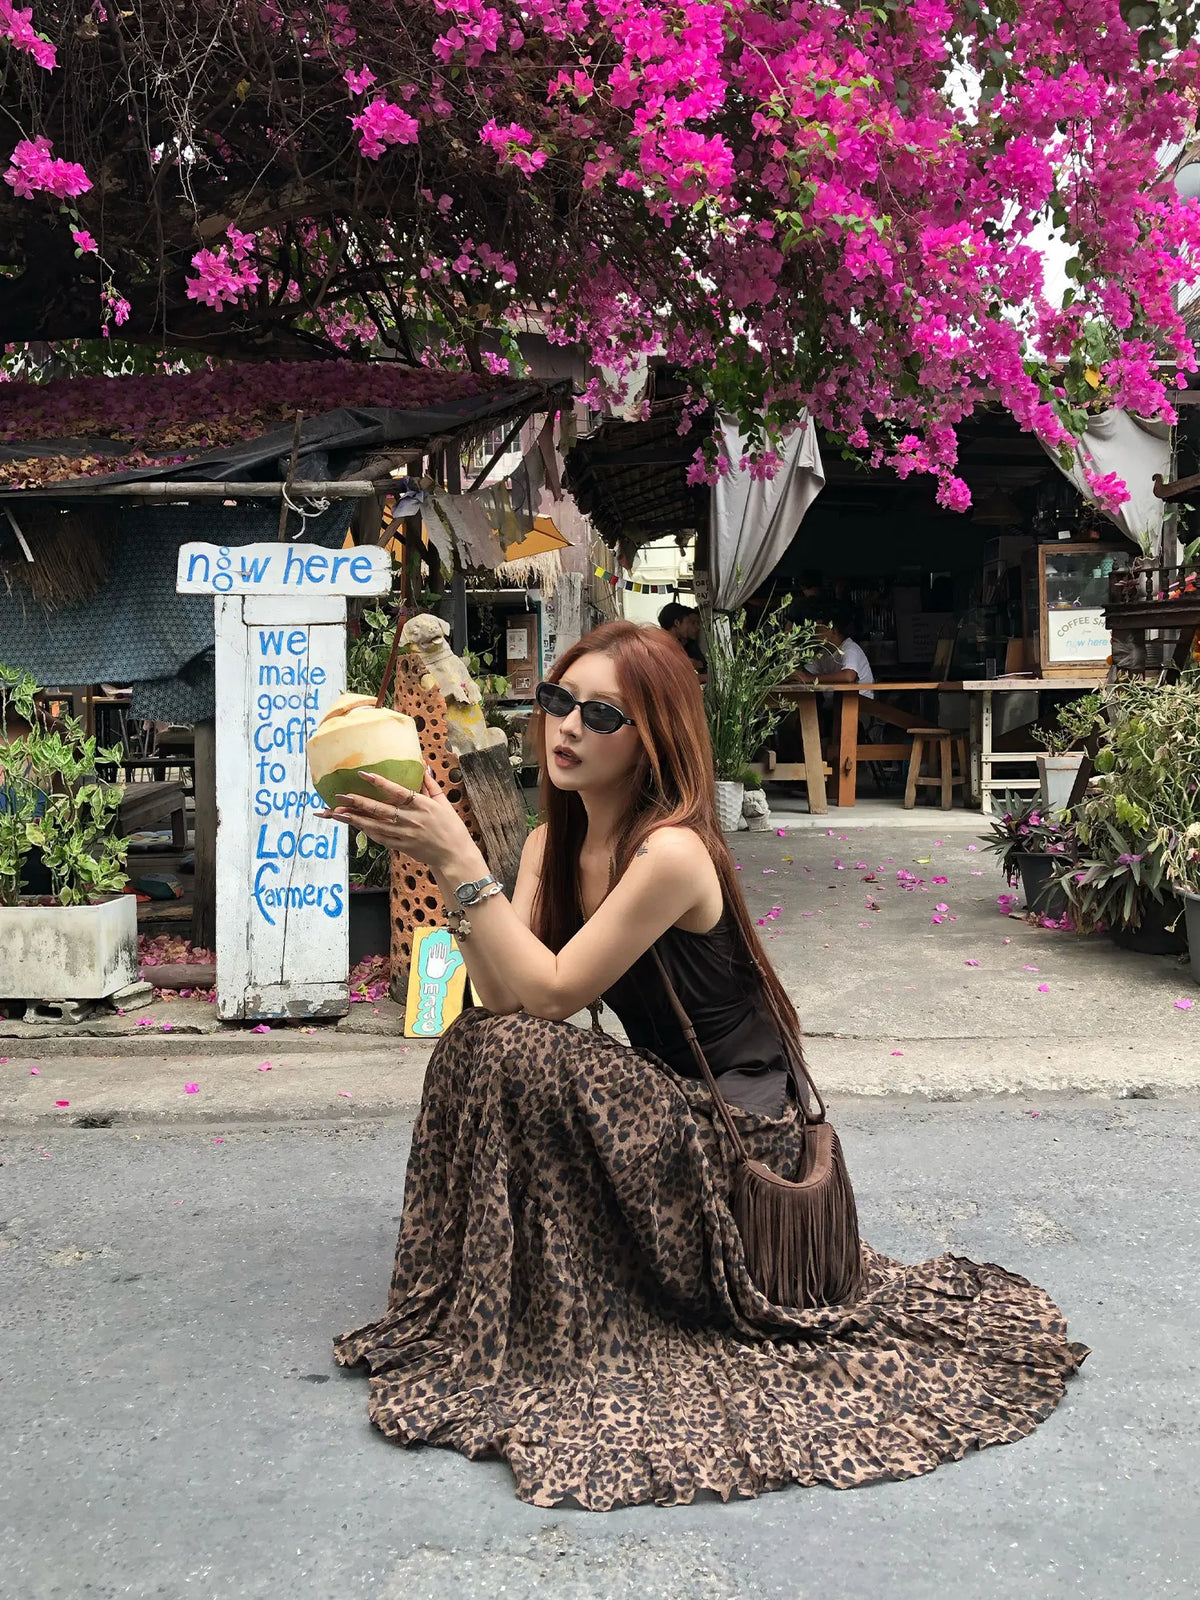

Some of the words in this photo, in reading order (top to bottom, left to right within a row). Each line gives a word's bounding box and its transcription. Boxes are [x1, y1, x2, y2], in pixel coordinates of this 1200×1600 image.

[283, 547, 373, 586] here
[1057, 616, 1090, 637] COFFEE
[1092, 617, 1105, 627] SH
[259, 630, 308, 656] we
[258, 659, 327, 686] make
[257, 689, 319, 720] good
[254, 716, 318, 754] Coff
[256, 756, 286, 784] to
[254, 788, 326, 819] Suppo
[256, 824, 339, 859] Local
[421, 982, 439, 1032] made
